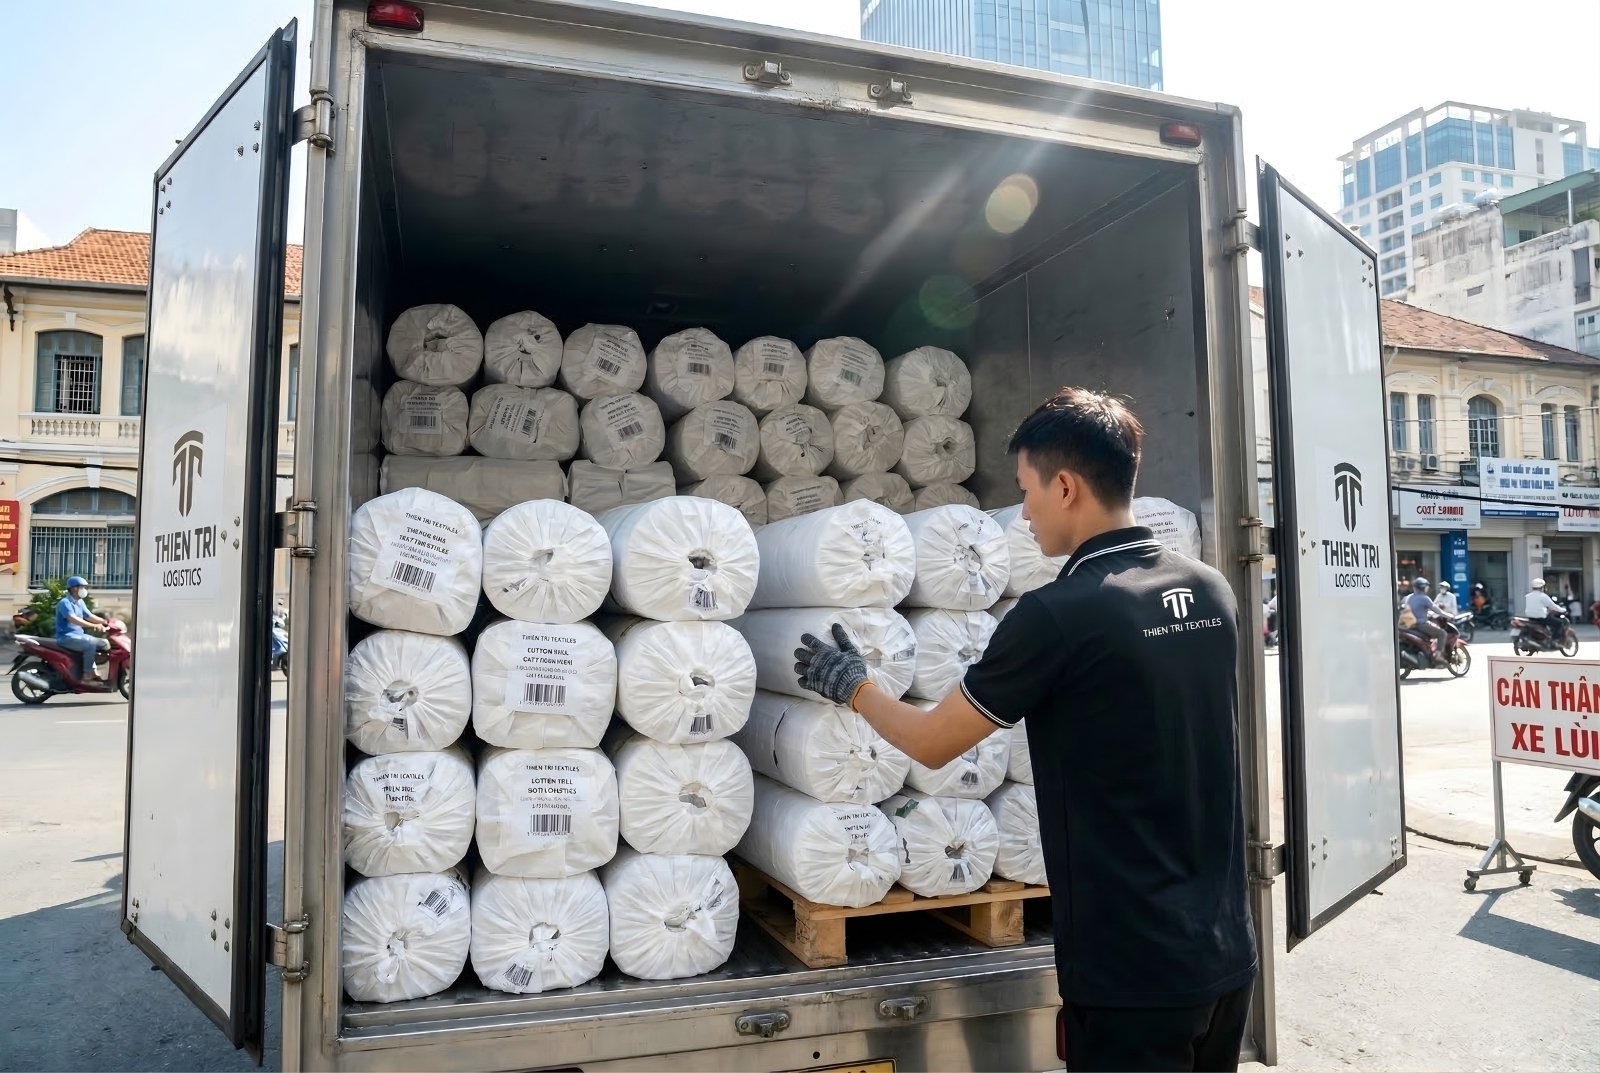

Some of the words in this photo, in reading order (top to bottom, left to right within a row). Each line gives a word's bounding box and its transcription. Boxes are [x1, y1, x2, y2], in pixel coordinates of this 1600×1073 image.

[155, 530, 191, 563] THIEN
[194, 524, 216, 559] TRI
[1322, 540, 1359, 567] THIEN
[1361, 544, 1379, 568] TRI
[163, 567, 202, 587] LOGISTICS
[1335, 573, 1371, 587] LOGISTICS
[1143, 626, 1168, 637] THIEN
[1170, 623, 1183, 633] TRI
[1184, 617, 1222, 631] TEXTILES
[1496, 666, 1541, 709] CẨN
[1511, 722, 1545, 753] XE
[1555, 722, 1600, 760] LÙI
